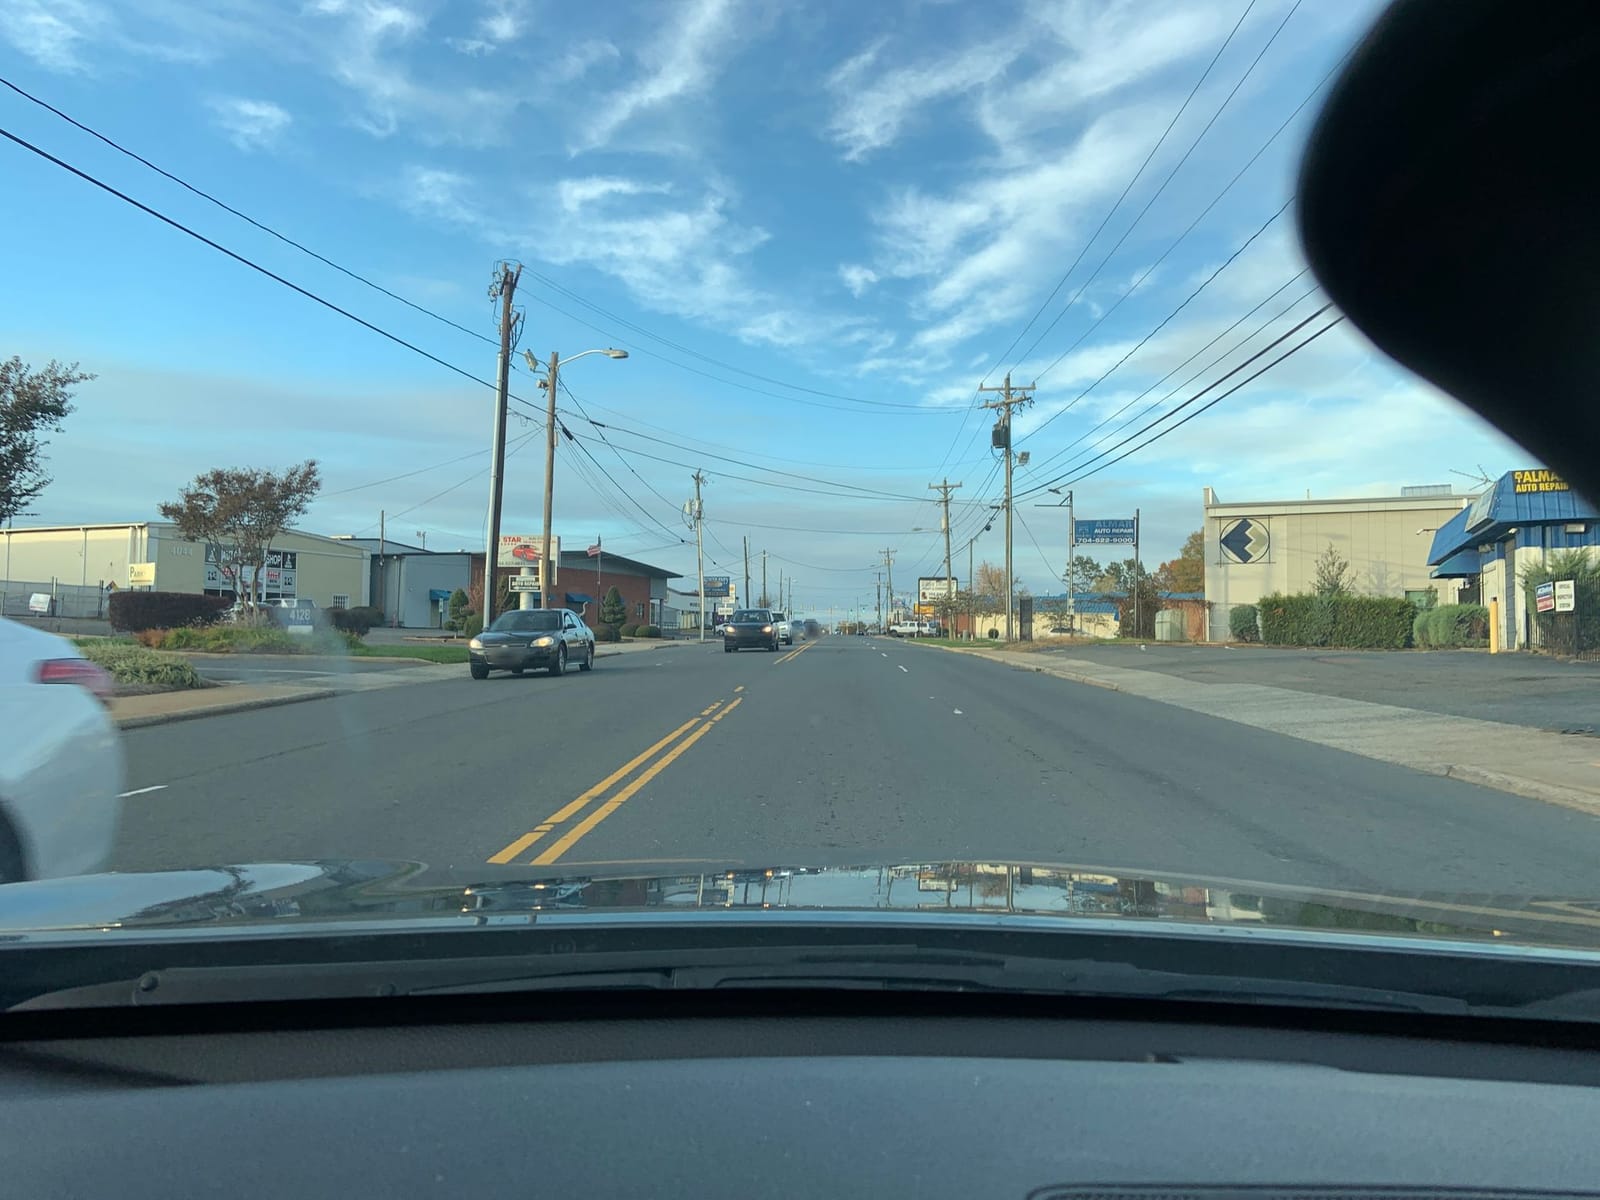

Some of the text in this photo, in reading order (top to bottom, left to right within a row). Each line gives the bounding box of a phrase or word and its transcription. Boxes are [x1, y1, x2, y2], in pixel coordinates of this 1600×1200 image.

[1523, 470, 1563, 483] ALMA
[1516, 483, 1537, 493] AUTO
[266, 554, 281, 565] SHOP
